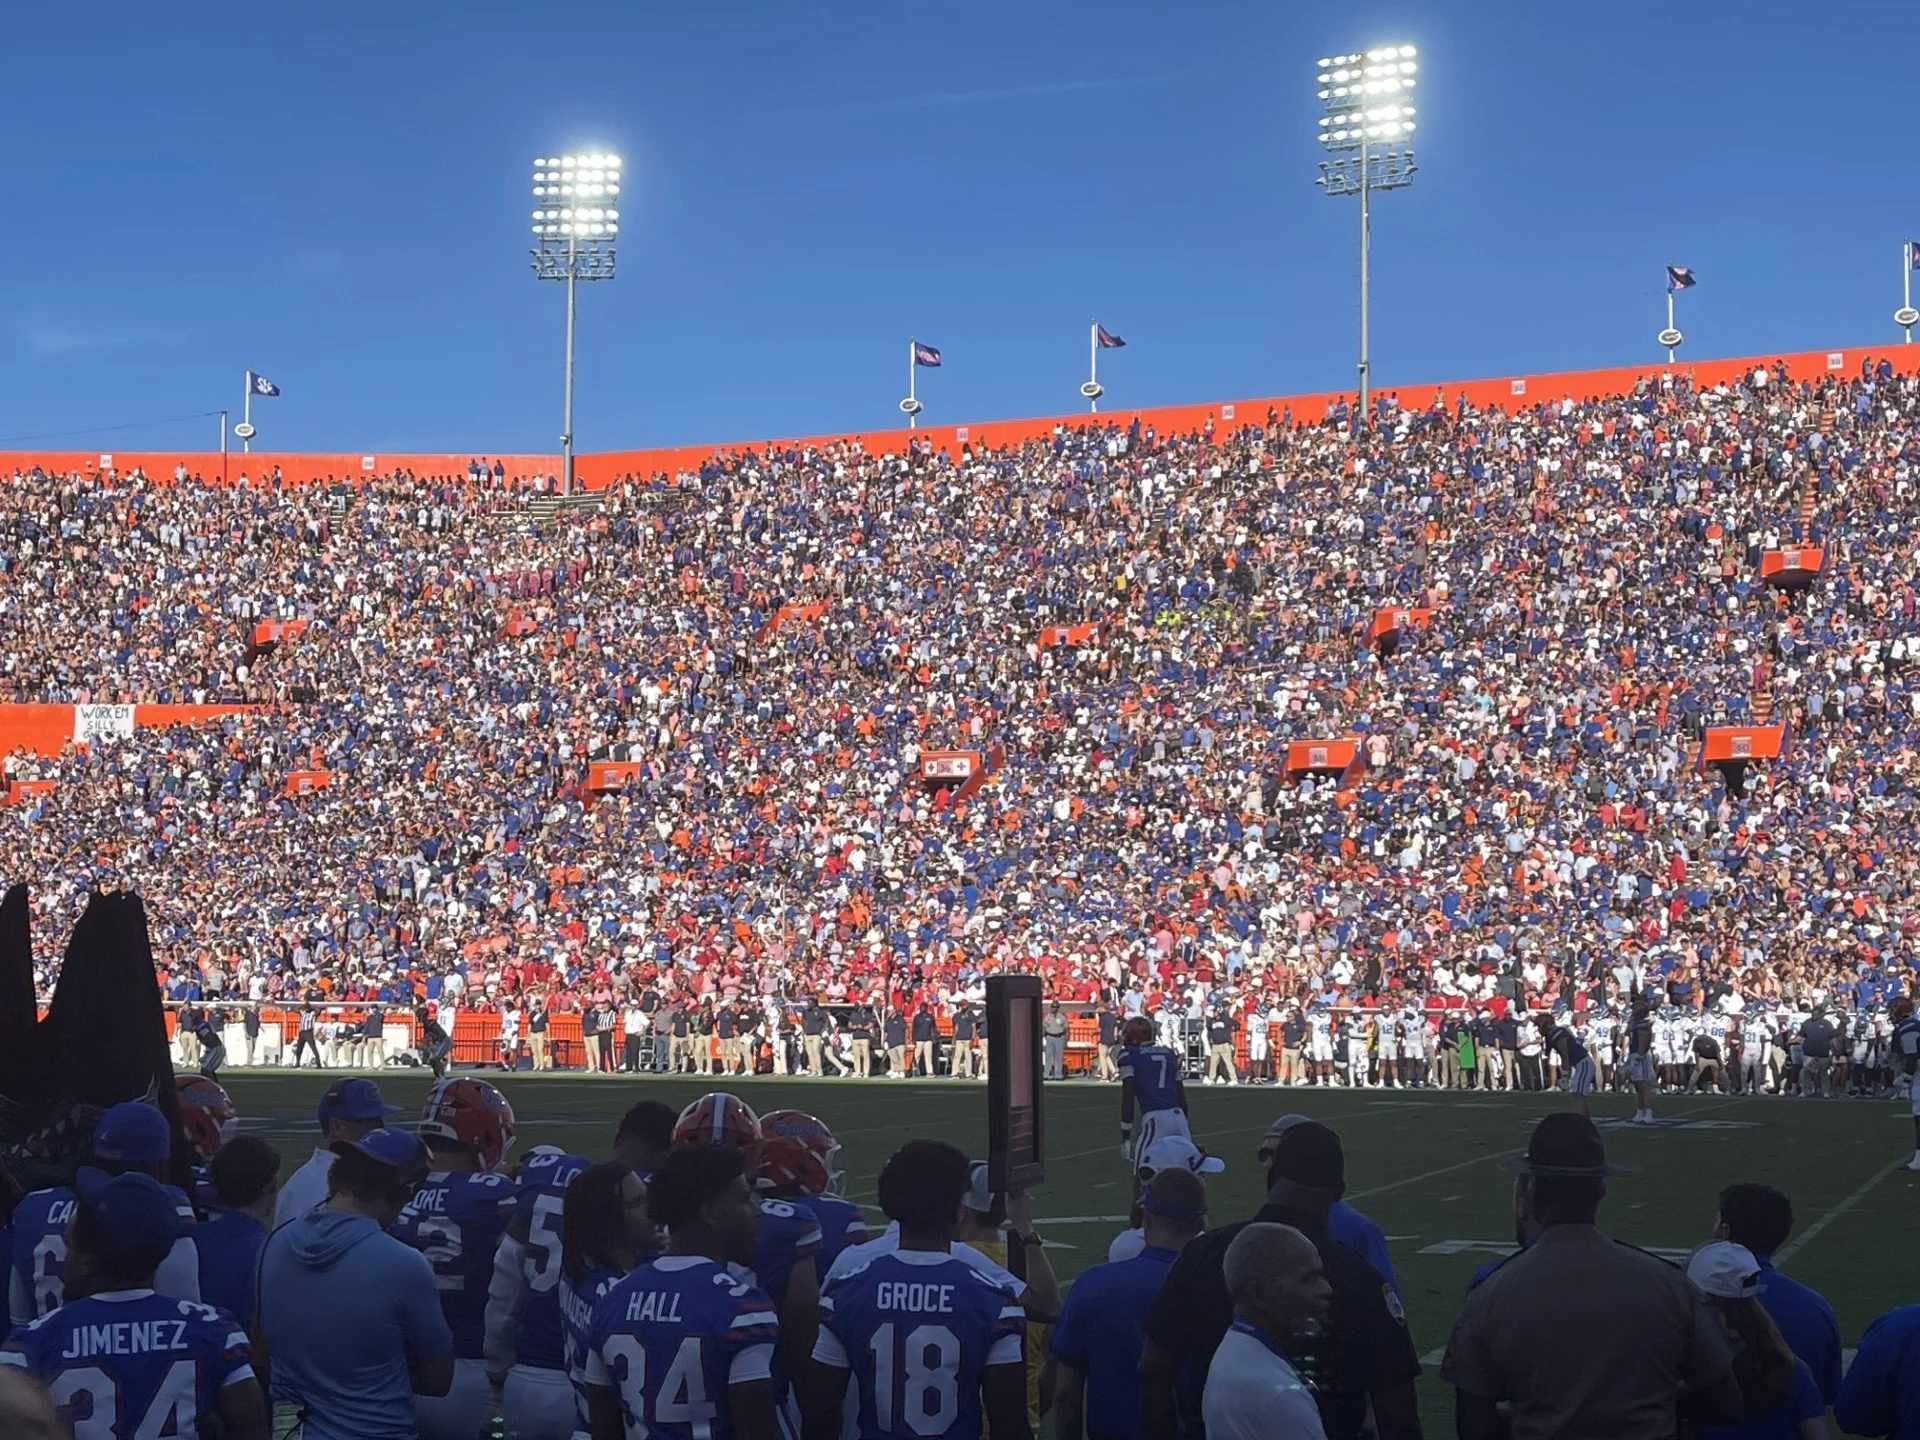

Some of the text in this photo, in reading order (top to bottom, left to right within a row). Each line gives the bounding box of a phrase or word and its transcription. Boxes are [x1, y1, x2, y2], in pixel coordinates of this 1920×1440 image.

[81, 706, 112, 719] WORK
[938, 763, 952, 773] 36
[1382, 1024, 1393, 1035] 12
[1744, 1031, 1757, 1043] 31
[1151, 1055, 1168, 1089] 7
[625, 1290, 683, 1323] HALL
[876, 1281, 956, 1313] GROCE
[61, 1319, 189, 1359] JIMENEZ
[601, 1333, 718, 1440] 34
[869, 1322, 961, 1437] 18
[49, 1359, 201, 1440] 34
